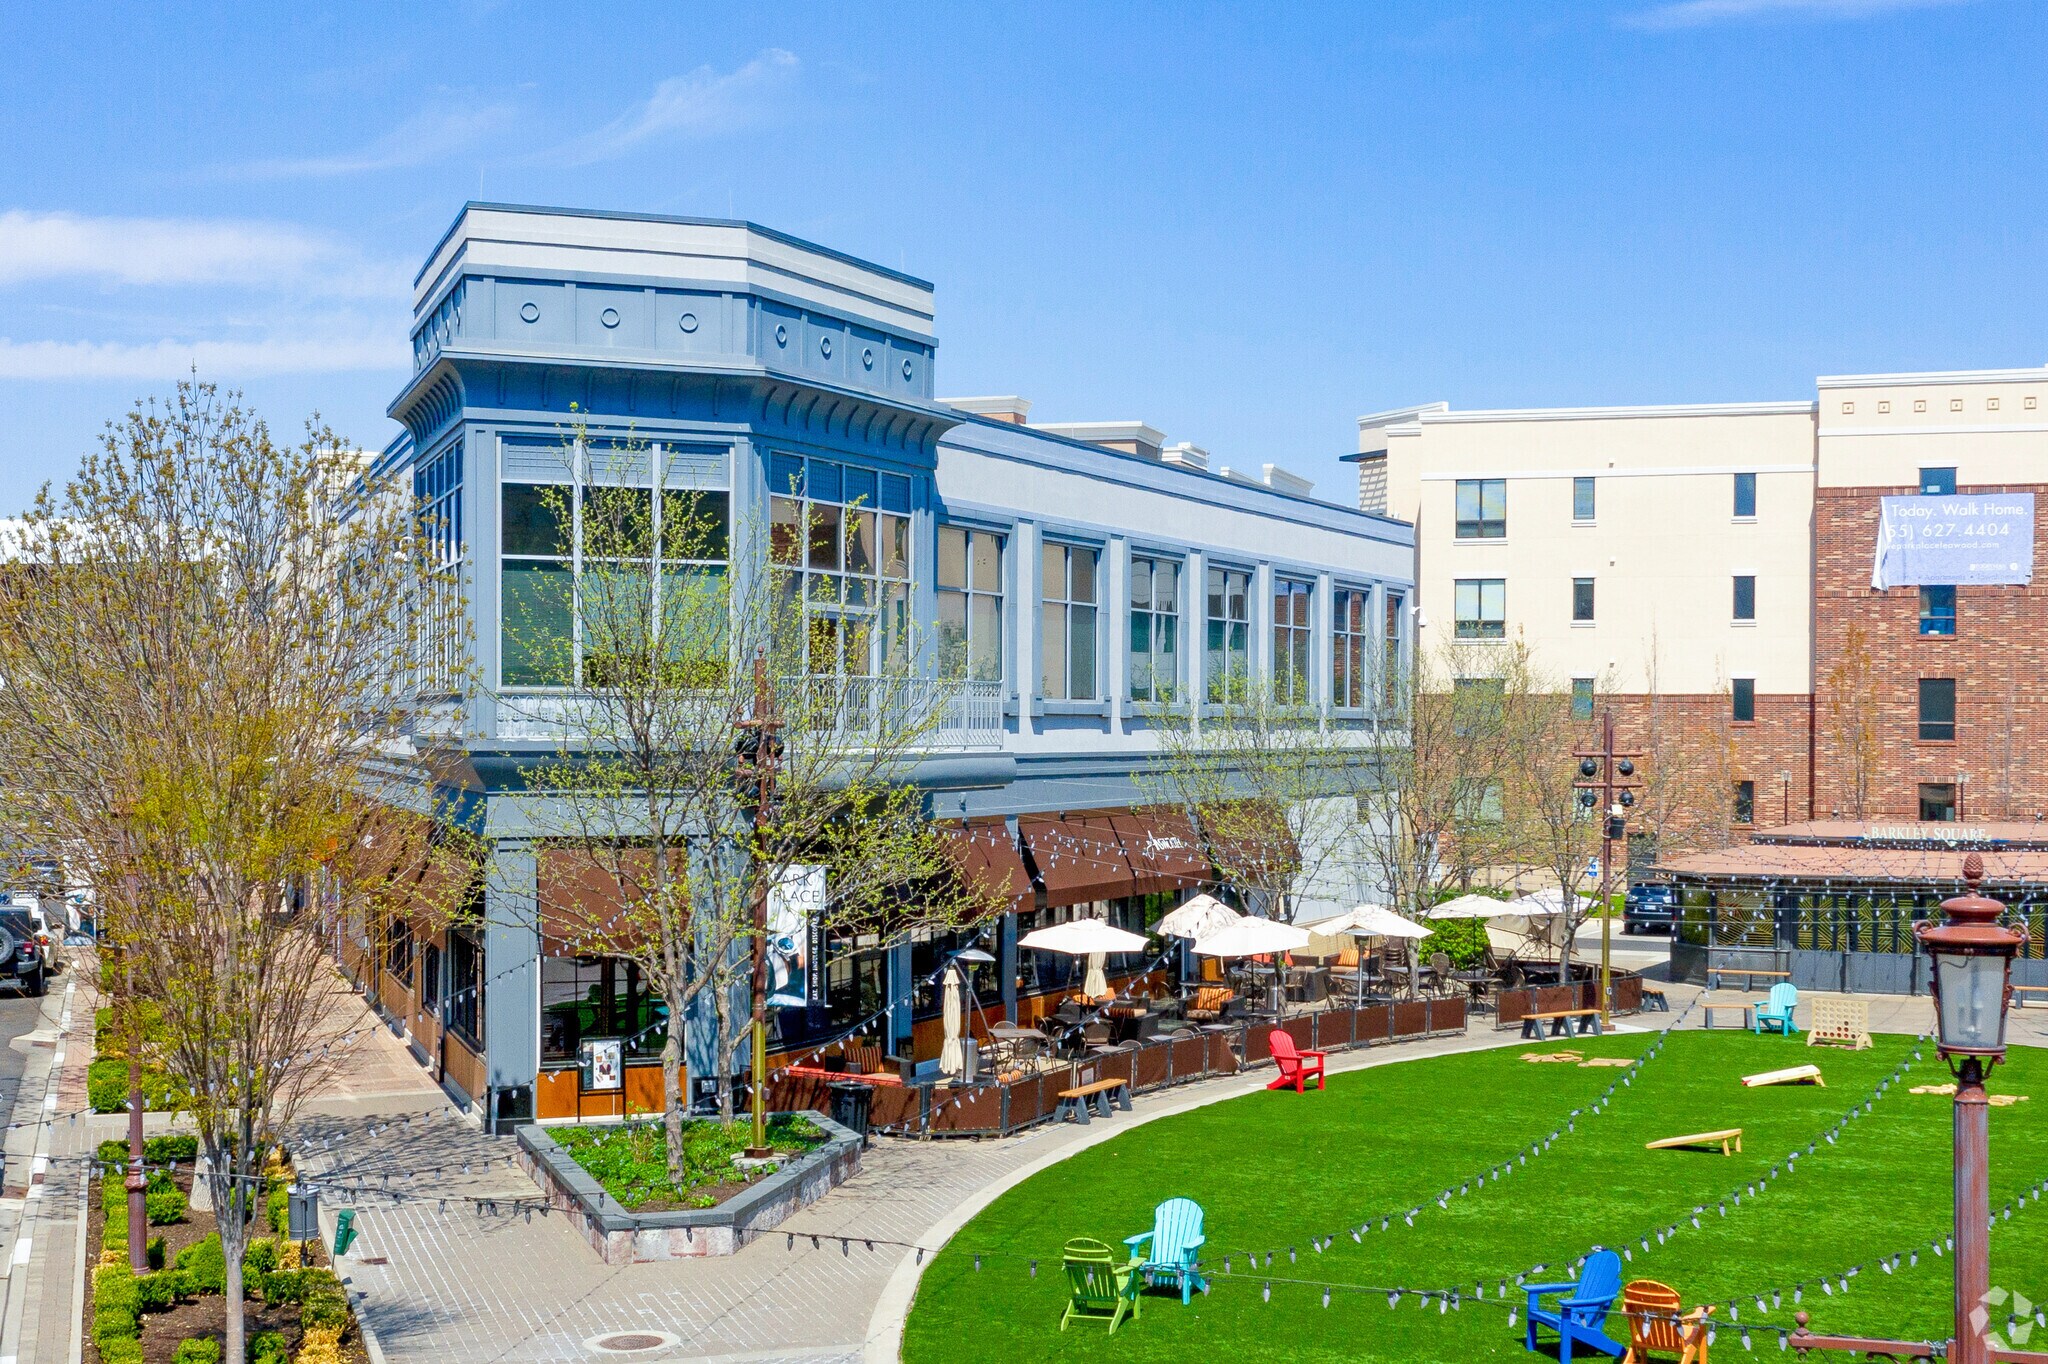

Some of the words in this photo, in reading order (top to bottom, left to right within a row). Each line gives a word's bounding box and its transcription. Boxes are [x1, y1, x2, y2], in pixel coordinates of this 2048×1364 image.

[1891, 504, 1937, 520] Today.
[1942, 503, 1979, 516] Walk
[1984, 503, 2028, 516] Home.
[1922, 522, 2009, 537] 627.4404
[1871, 827, 1929, 840] BARKLEY
[1933, 827, 1986, 842] SQUARE
[773, 890, 819, 903] PLACE
